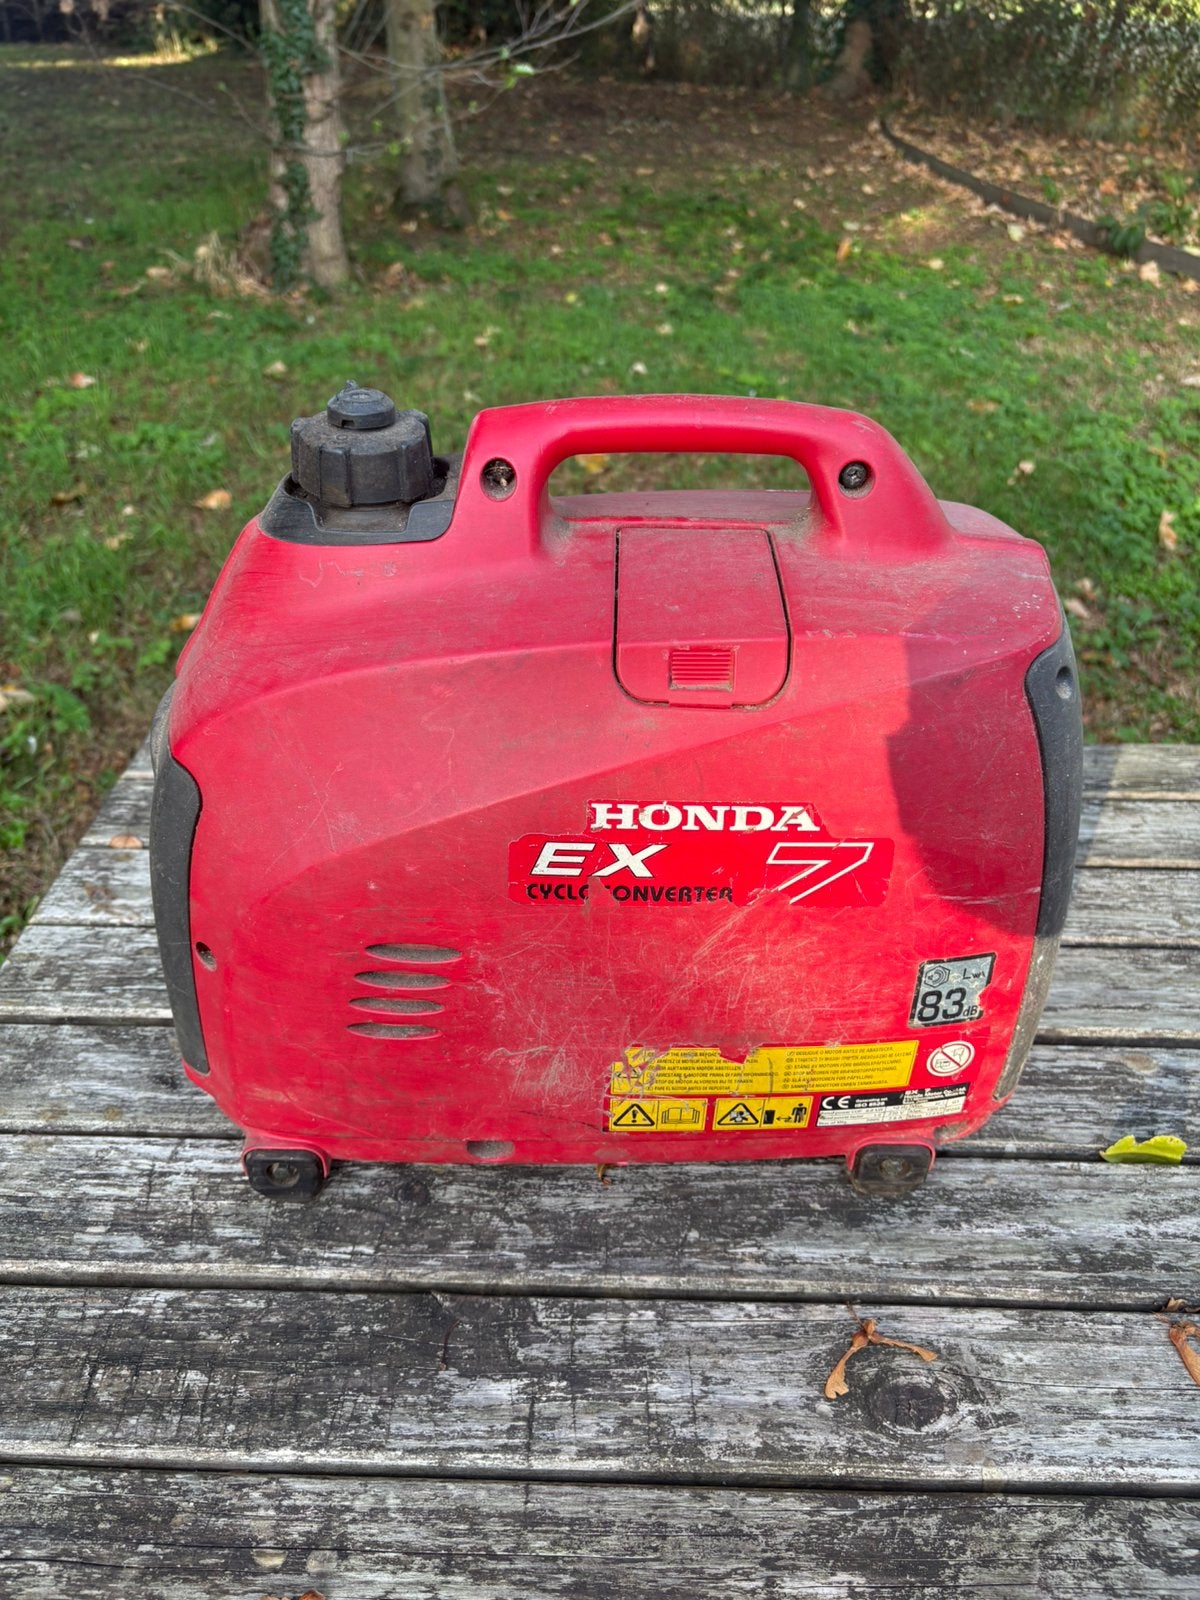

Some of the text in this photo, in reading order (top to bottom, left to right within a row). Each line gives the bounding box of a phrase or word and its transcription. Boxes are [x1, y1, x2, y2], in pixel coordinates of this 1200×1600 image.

[591, 803, 820, 831] HONDA
[529, 841, 875, 905] EX 7
[821, 1095, 851, 1110] CE
